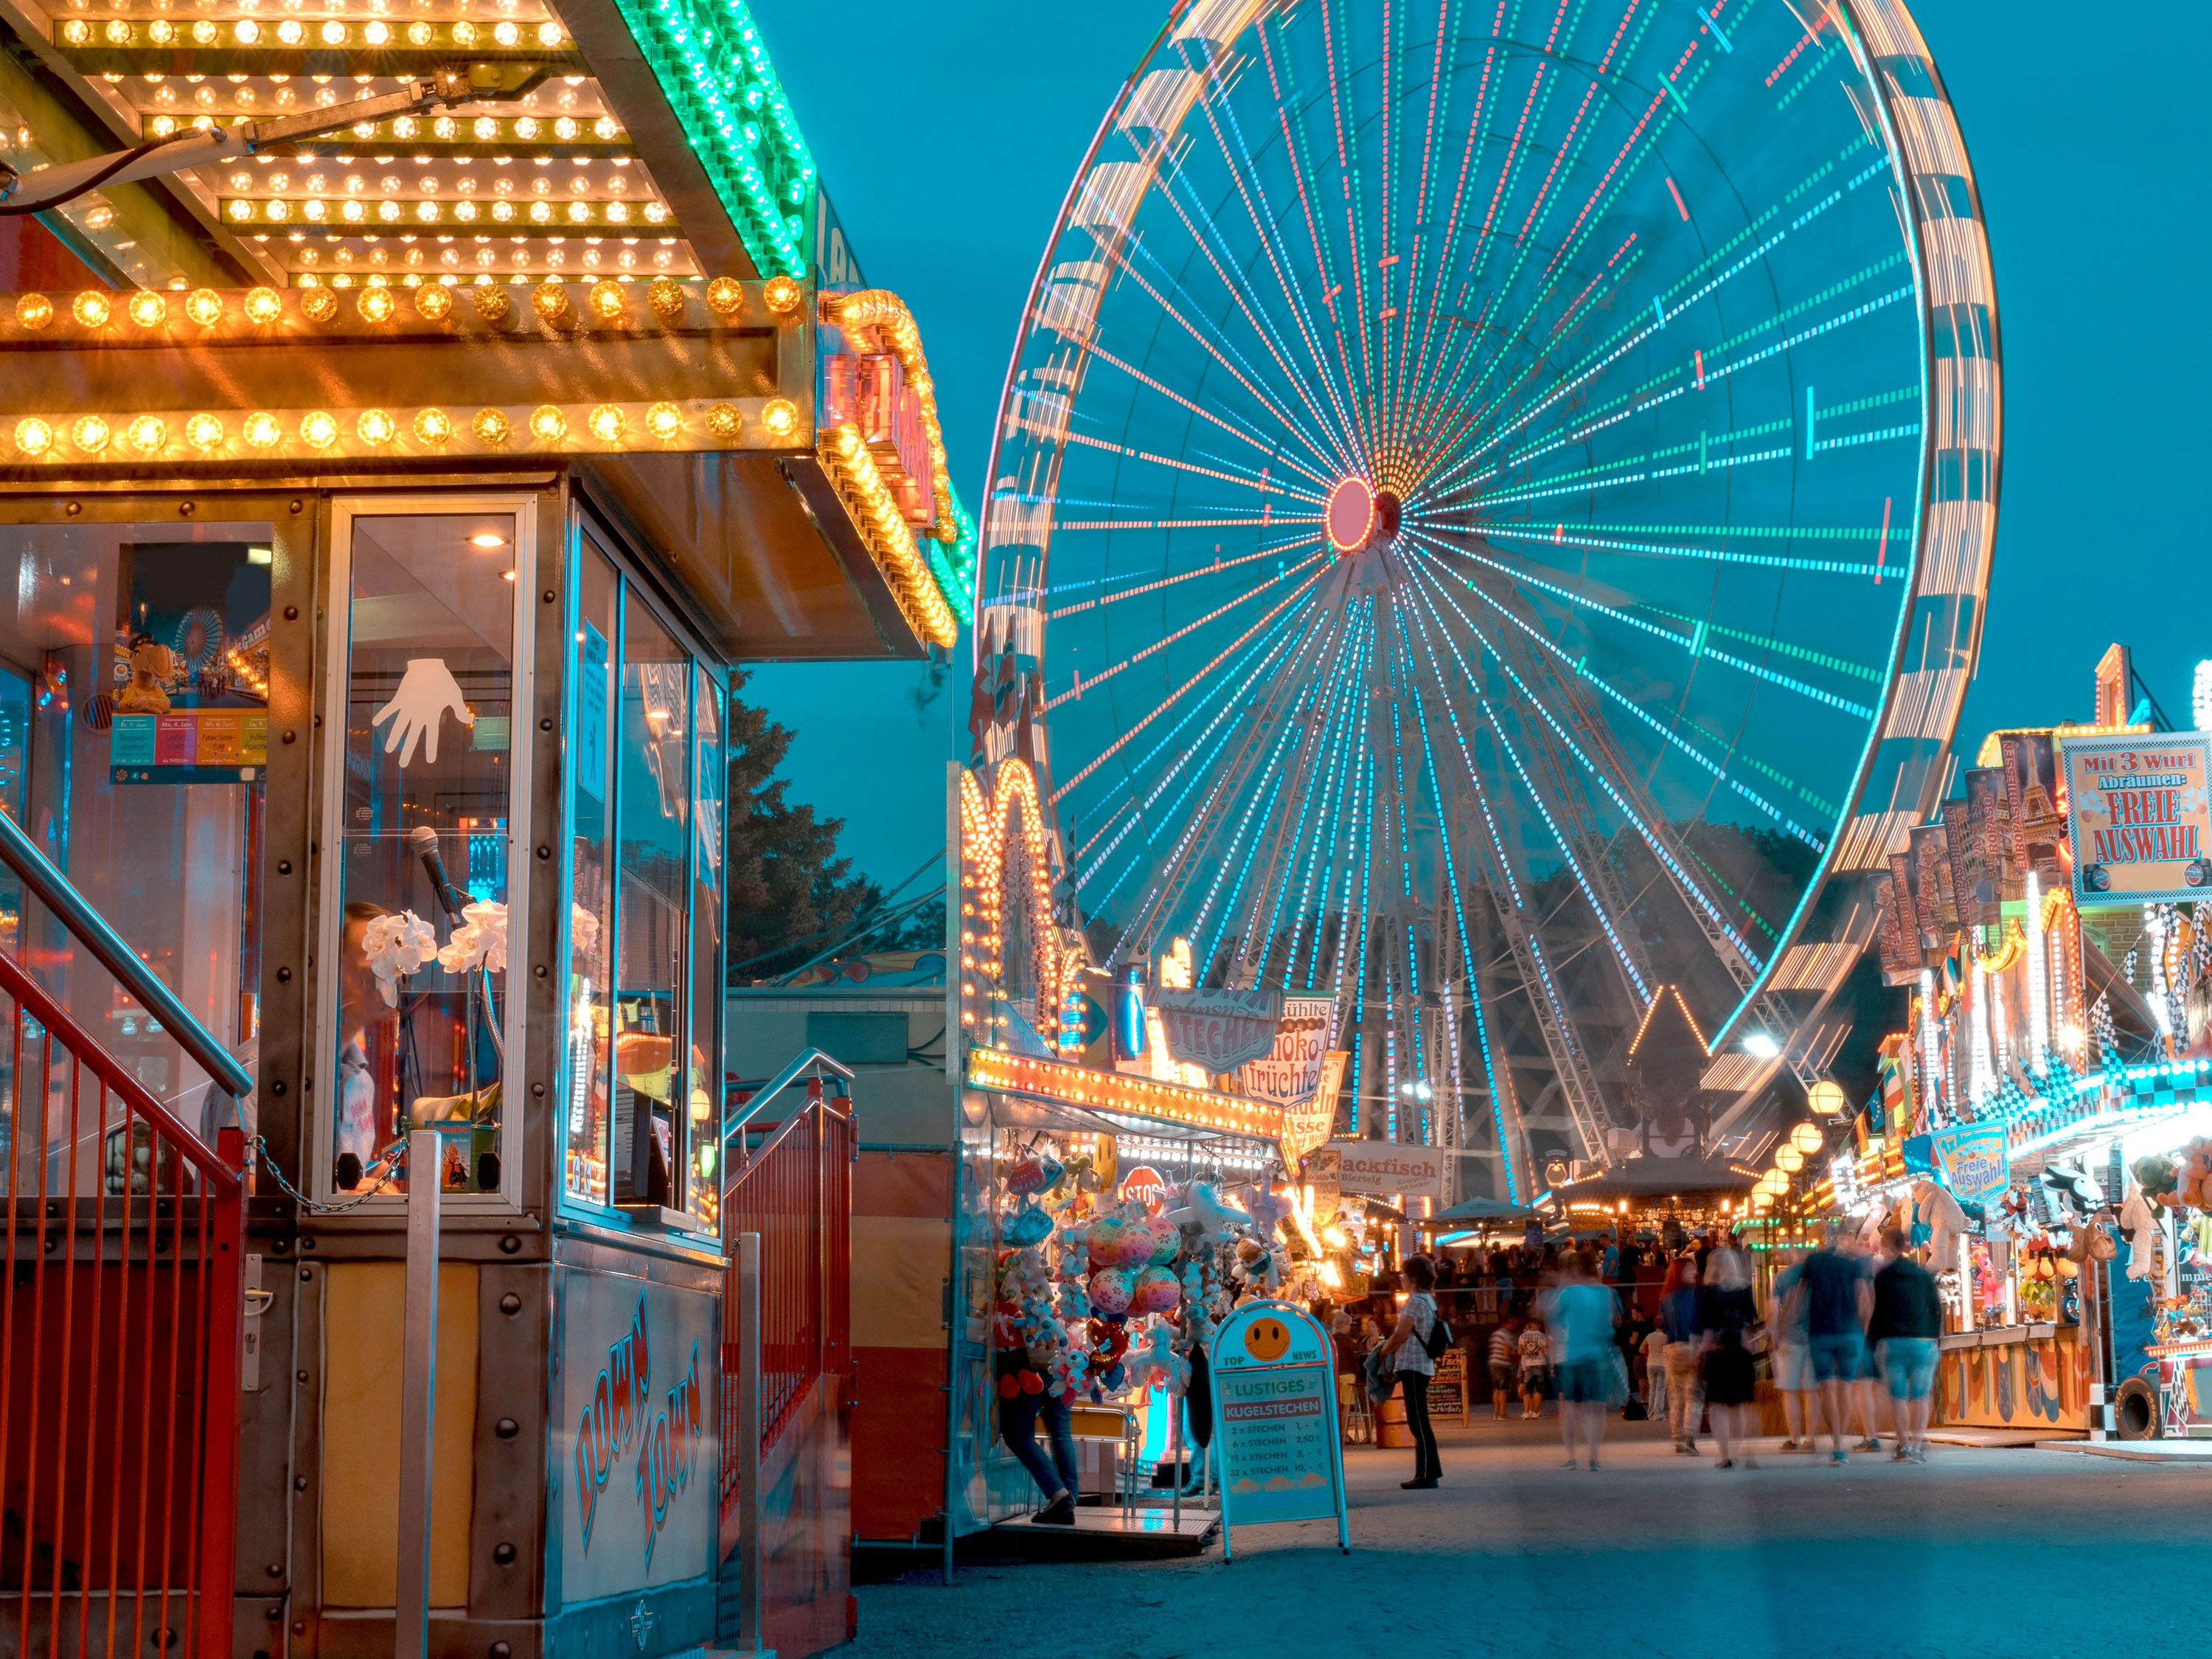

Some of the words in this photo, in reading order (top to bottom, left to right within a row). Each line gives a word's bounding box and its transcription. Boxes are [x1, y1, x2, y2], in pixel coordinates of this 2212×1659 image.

[2084, 756, 2117, 773] Mit
[2120, 752, 2139, 771] 3
[2143, 753, 2197, 771] Wurf
[2098, 773, 2187, 790] Abräumen:
[2003, 740, 2029, 871] EUROPASCHIESSEN
[2105, 789, 2180, 827] FREIE
[2093, 825, 2202, 865] AUSWAHL
[1944, 805, 1970, 922] EUROPASCHIESSEN
[1165, 1011, 1270, 1060] STECHEN
[1248, 1061, 1318, 1099] früchte
[1295, 1120, 1325, 1133] sse
[1340, 1158, 1437, 1178] ackfisch
[1952, 1153, 2006, 1186] Auswahl!
[1957, 1156, 1987, 1175] Freie
[1340, 1173, 1382, 1186] Bierteig
[1395, 1183, 1408, 1192] und
[1409, 1180, 1430, 1189] locker
[1126, 1183, 1159, 1207] STOP
[1222, 1356, 1245, 1366] TOP
[1292, 1350, 1317, 1360] NEWS
[1442, 1354, 1461, 1366] Fisch
[1235, 1379, 1306, 1397] LUSTIGES
[573, 1284, 651, 1553] DOWN
[1225, 1401, 1319, 1418] KUGELSTECHEN
[1232, 1427, 1237, 1435] 2
[1247, 1423, 1286, 1435] STECHEN
[1315, 1420, 1321, 1428] €
[1248, 1437, 1287, 1447] STECHEN
[1296, 1435, 1315, 1444] 2,50
[1315, 1434, 1321, 1442] €
[635, 1336, 704, 1569] TOWN
[1230, 1454, 1239, 1463] 15
[1249, 1451, 1287, 1461] STECHEN
[1230, 1468, 1239, 1476] 32
[1251, 1464, 1289, 1475] STECHEN
[1318, 1461, 1324, 1470] €
